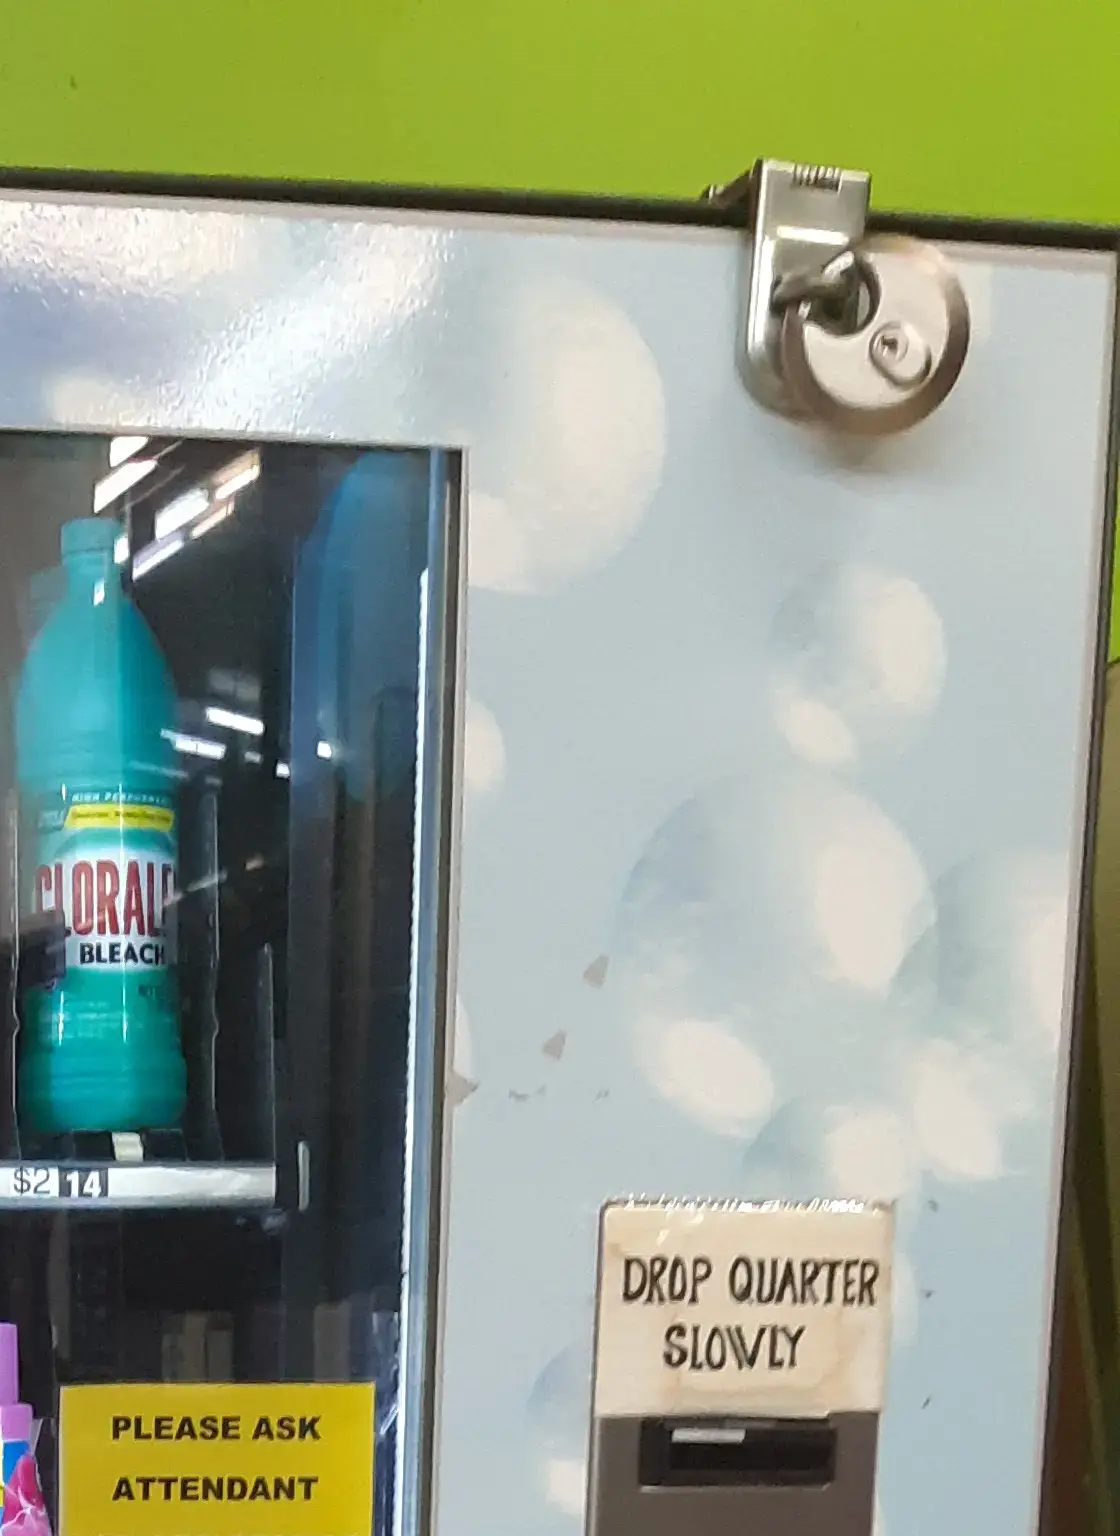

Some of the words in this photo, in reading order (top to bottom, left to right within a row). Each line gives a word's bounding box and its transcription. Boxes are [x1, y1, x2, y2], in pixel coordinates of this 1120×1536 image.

[80, 942, 167, 966] BLEACH
[13, 1167, 52, 1196] $2
[66, 1170, 103, 1196] 14
[622, 1256, 712, 1305] DROP
[729, 1256, 880, 1307] QUARTER
[662, 1325, 806, 1371] SLOWLY
[111, 1417, 241, 1441] PLEASE
[252, 1416, 322, 1441] ASK
[112, 1477, 319, 1501] ATTENDANT
